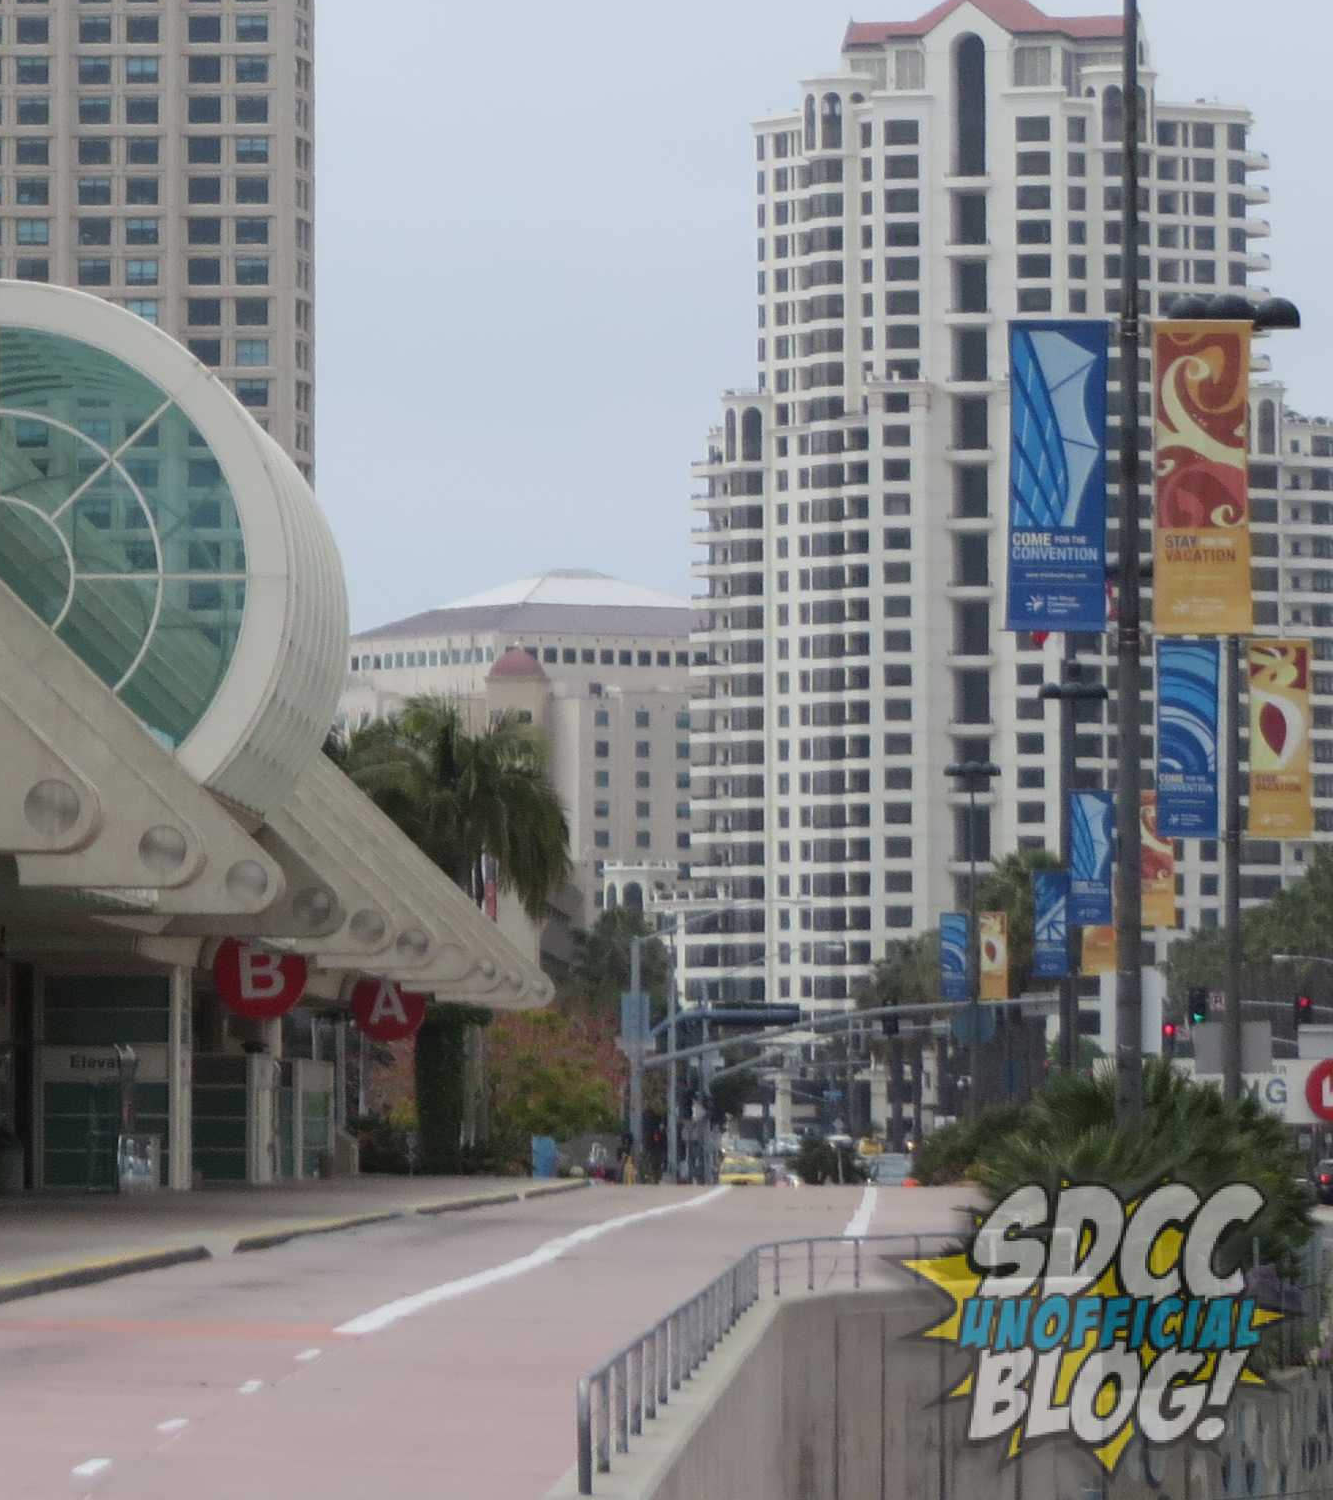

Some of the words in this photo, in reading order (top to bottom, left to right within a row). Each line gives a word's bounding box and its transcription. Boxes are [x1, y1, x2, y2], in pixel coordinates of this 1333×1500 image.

[1012, 532, 1052, 546] COME
[1165, 534, 1197, 548] STAY
[1012, 547, 1098, 561] CONVENTION
[1165, 548, 1237, 562] VACATION
[238, 945, 286, 998] B
[369, 979, 408, 1024] A
